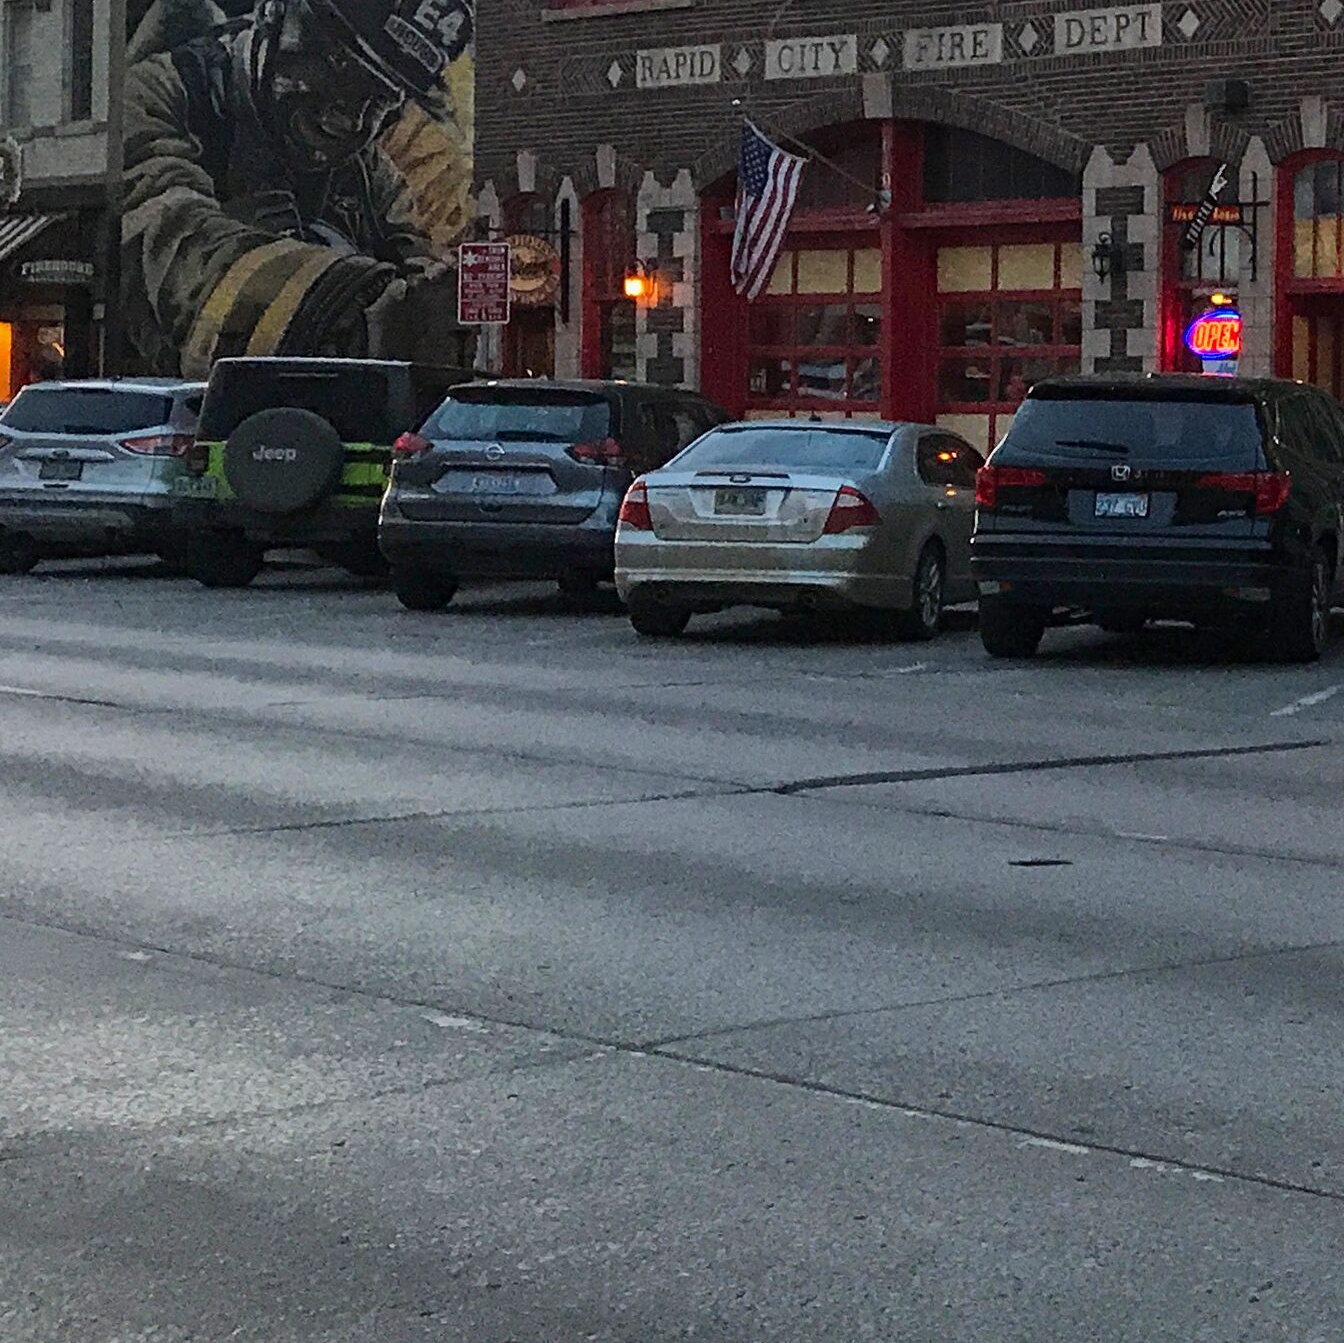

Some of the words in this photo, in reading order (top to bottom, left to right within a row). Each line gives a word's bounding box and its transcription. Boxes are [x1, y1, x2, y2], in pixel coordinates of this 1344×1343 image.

[640, 48, 716, 84] RAPID
[777, 40, 852, 75] CITY
[914, 29, 989, 64] FIRE
[1065, 9, 1152, 50] DEPT
[1193, 320, 1241, 352] OPEN
[252, 445, 298, 461] Jeep
